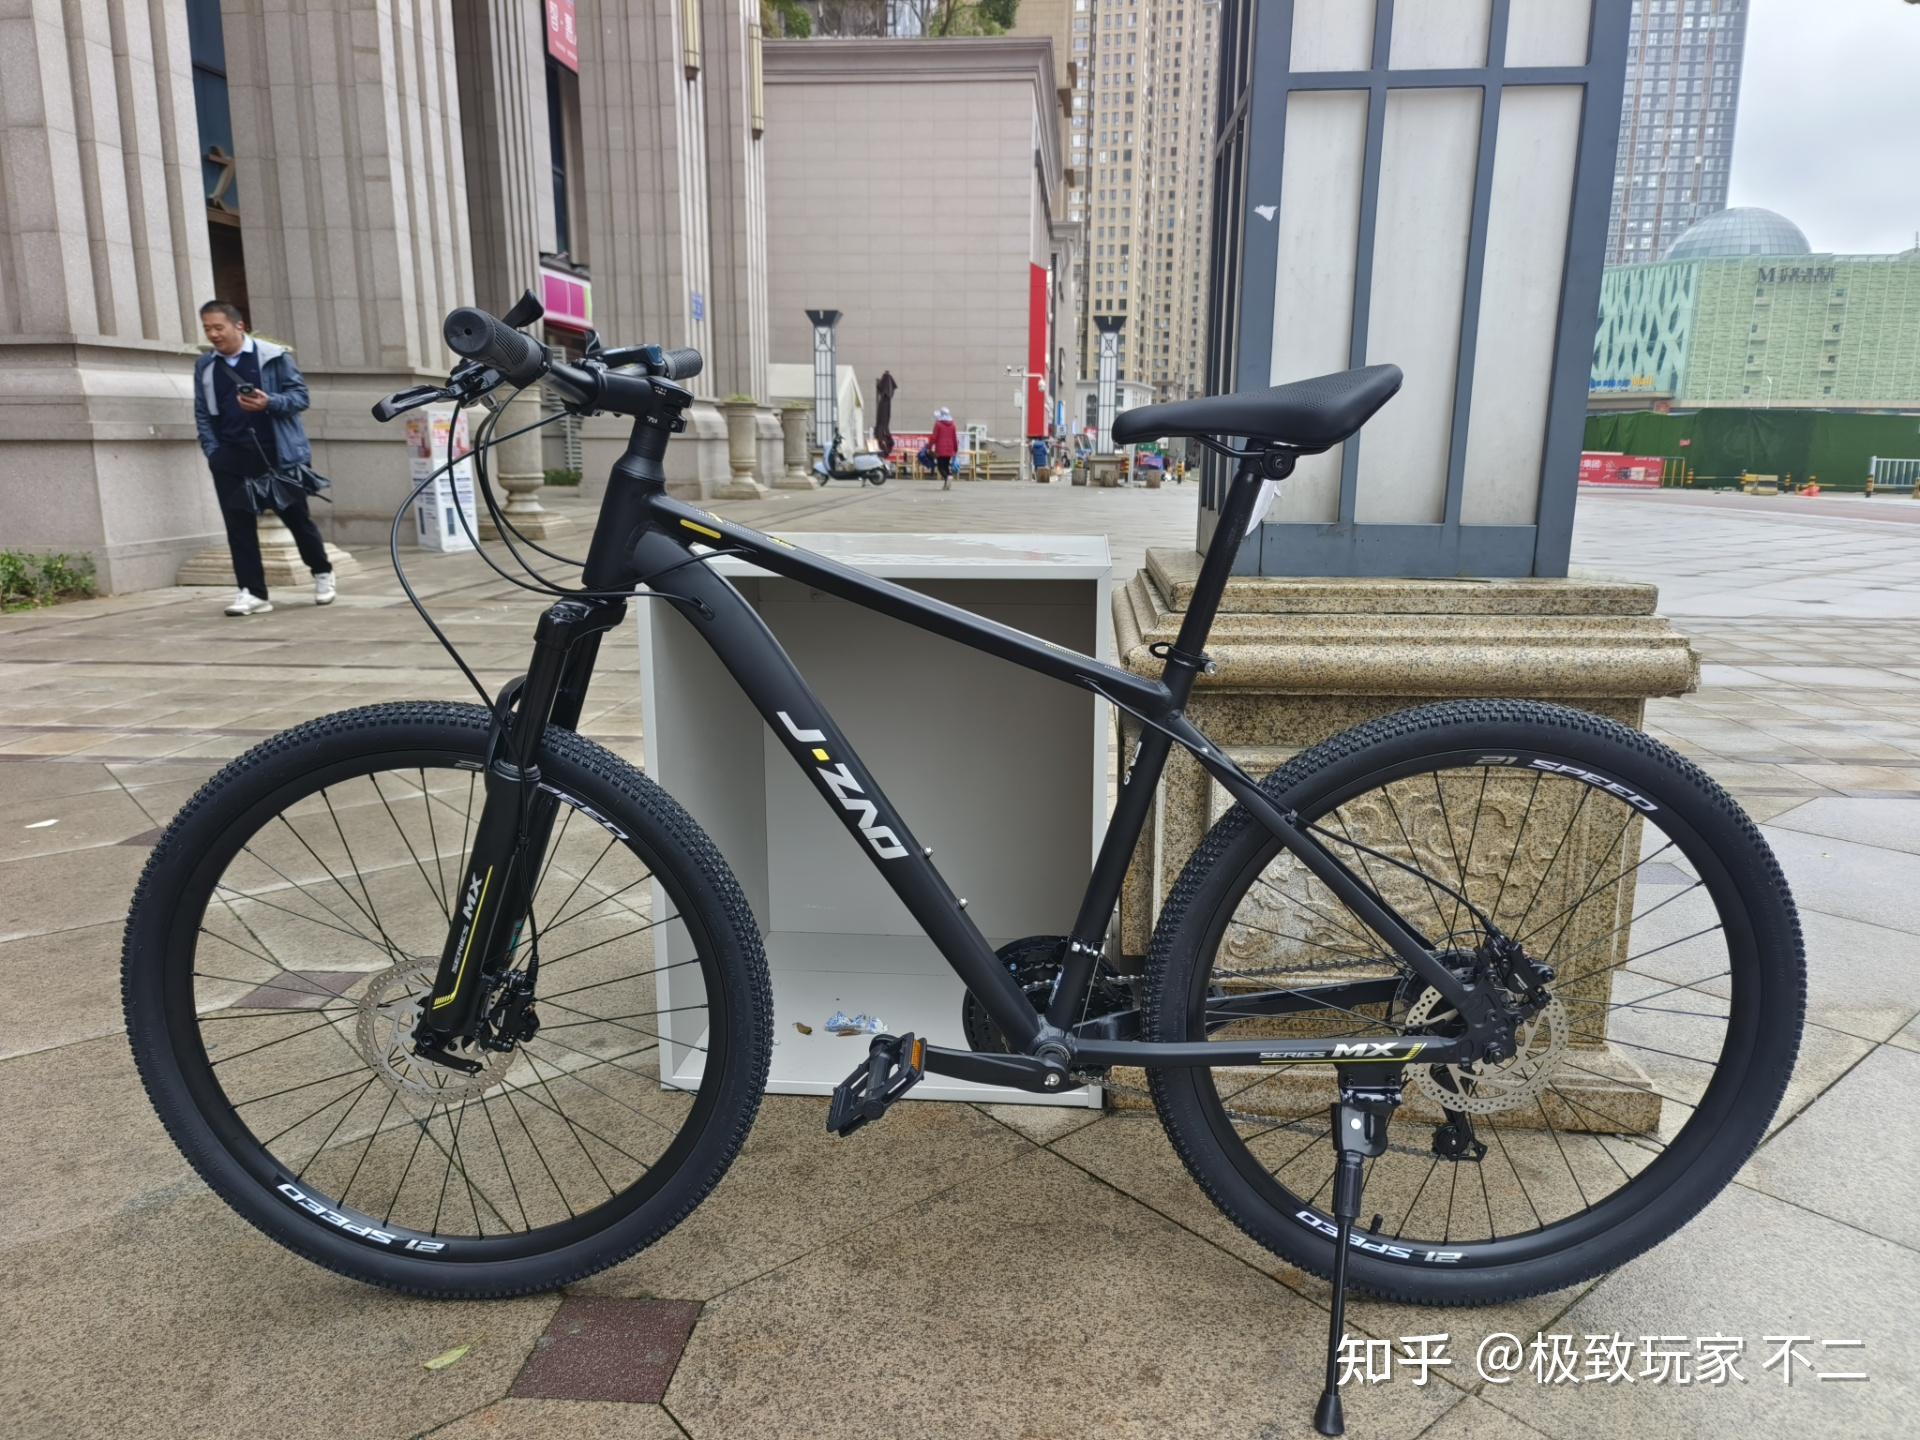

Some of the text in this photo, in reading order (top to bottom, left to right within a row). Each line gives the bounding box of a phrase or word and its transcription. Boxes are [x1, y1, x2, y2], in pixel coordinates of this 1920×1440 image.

[537, 782, 630, 839] PEED
[1528, 759, 1659, 811] SPEED
[462, 872, 483, 921] MX
[1259, 1042, 1399, 1059] SERIES MX
[276, 1183, 397, 1244] SPEED
